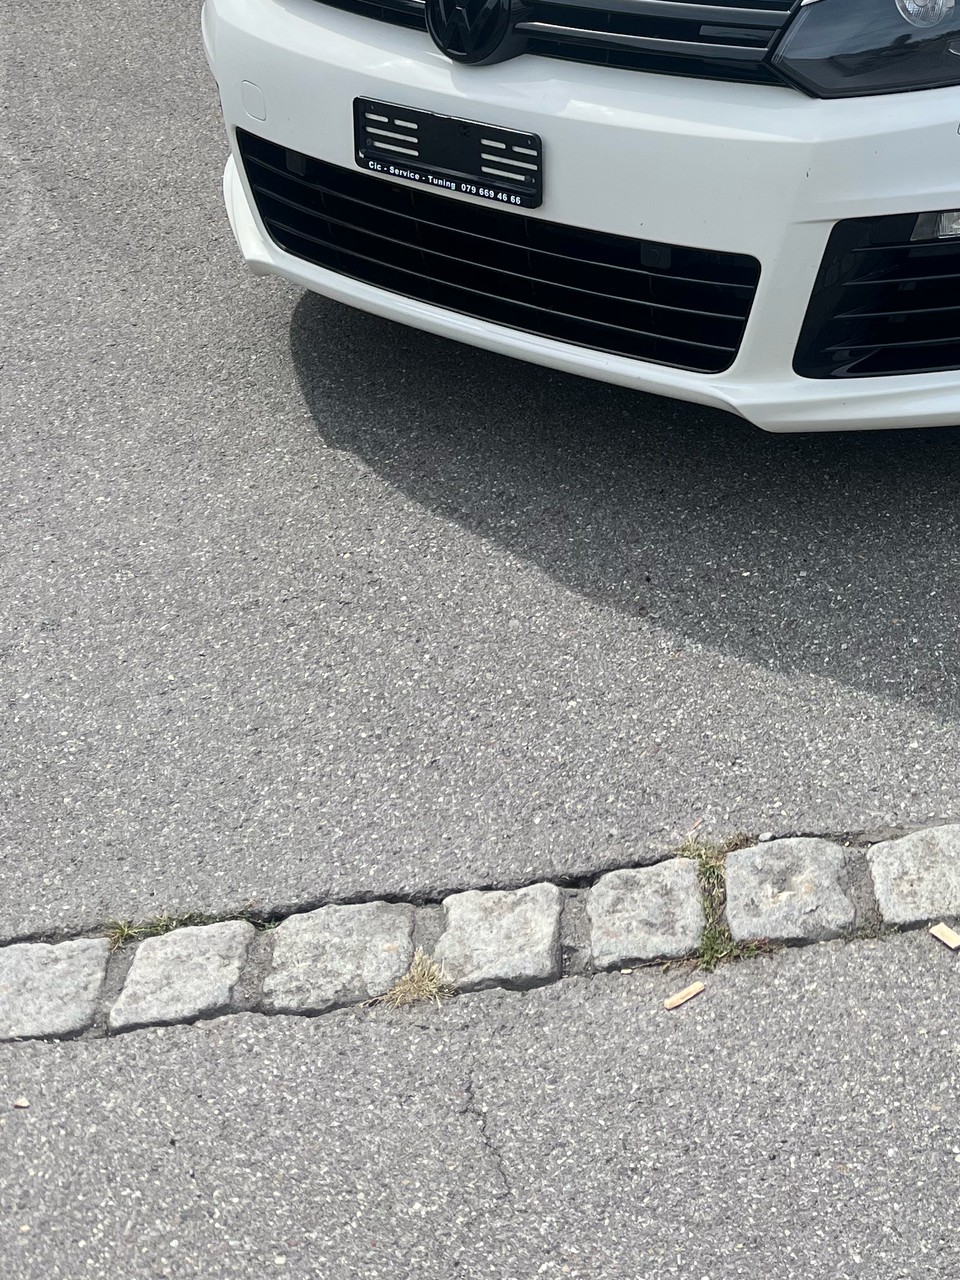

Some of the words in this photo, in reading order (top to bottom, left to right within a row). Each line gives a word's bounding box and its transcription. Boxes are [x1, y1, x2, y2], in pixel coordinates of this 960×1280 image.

[389, 166, 420, 181] Service
[428, 175, 456, 190] Tuning
[461, 183, 476, 195] 079
[479, 188, 494, 199] 669
[497, 192, 508, 202] 46
[510, 195, 521, 205] 66
